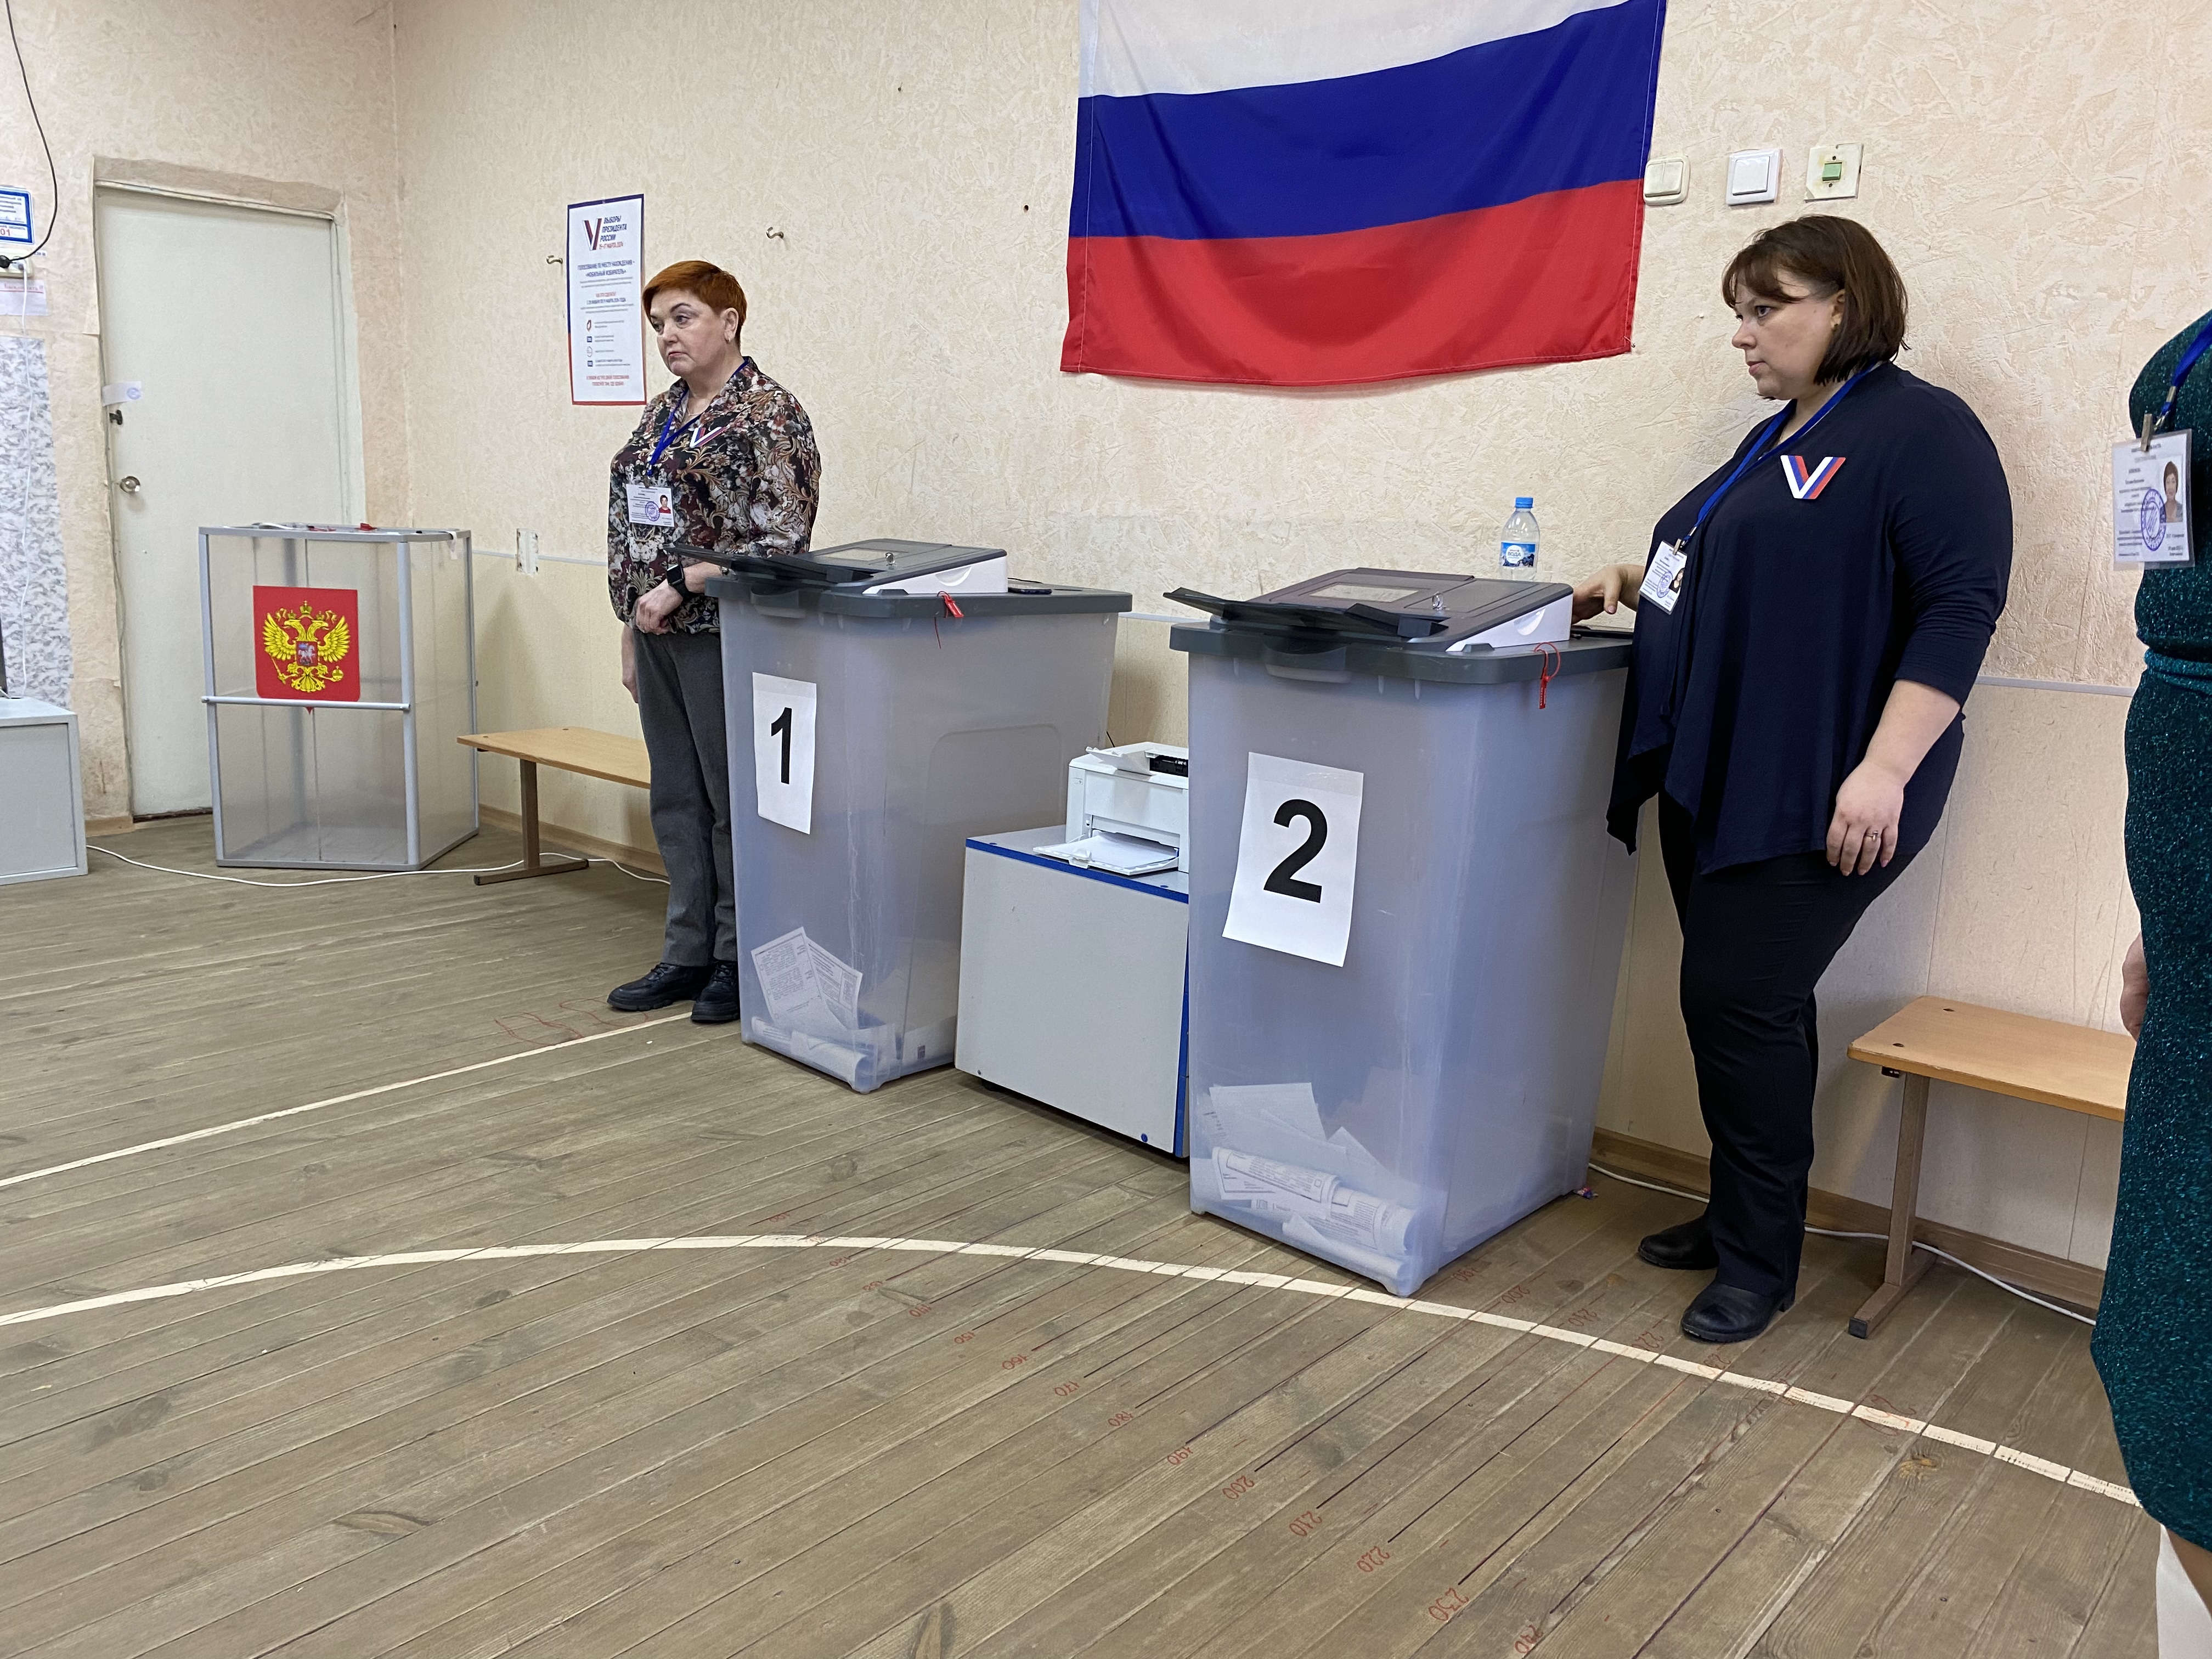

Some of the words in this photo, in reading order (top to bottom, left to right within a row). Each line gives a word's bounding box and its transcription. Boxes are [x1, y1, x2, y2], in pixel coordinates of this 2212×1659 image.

[602, 224, 627, 233] ПРЕЗИДЕНТА
[604, 216, 621, 224] ВЫБОРЫ
[600, 234, 616, 242] РОССИИ
[771, 707, 792, 785] 1
[1263, 799, 1328, 904] 2
[1501, 1285, 1530, 1304] 200
[953, 1330, 976, 1345] 150
[1001, 1353, 1028, 1370] 160
[1054, 1380, 1081, 1397] 170
[1108, 1410, 1134, 1427] 180
[1166, 1445, 1194, 1466] 190
[1222, 1474, 1255, 1500] 200
[1289, 1510, 1323, 1537] 210
[1356, 1545, 1391, 1573] 220
[1427, 1587, 1469, 1622] 230
